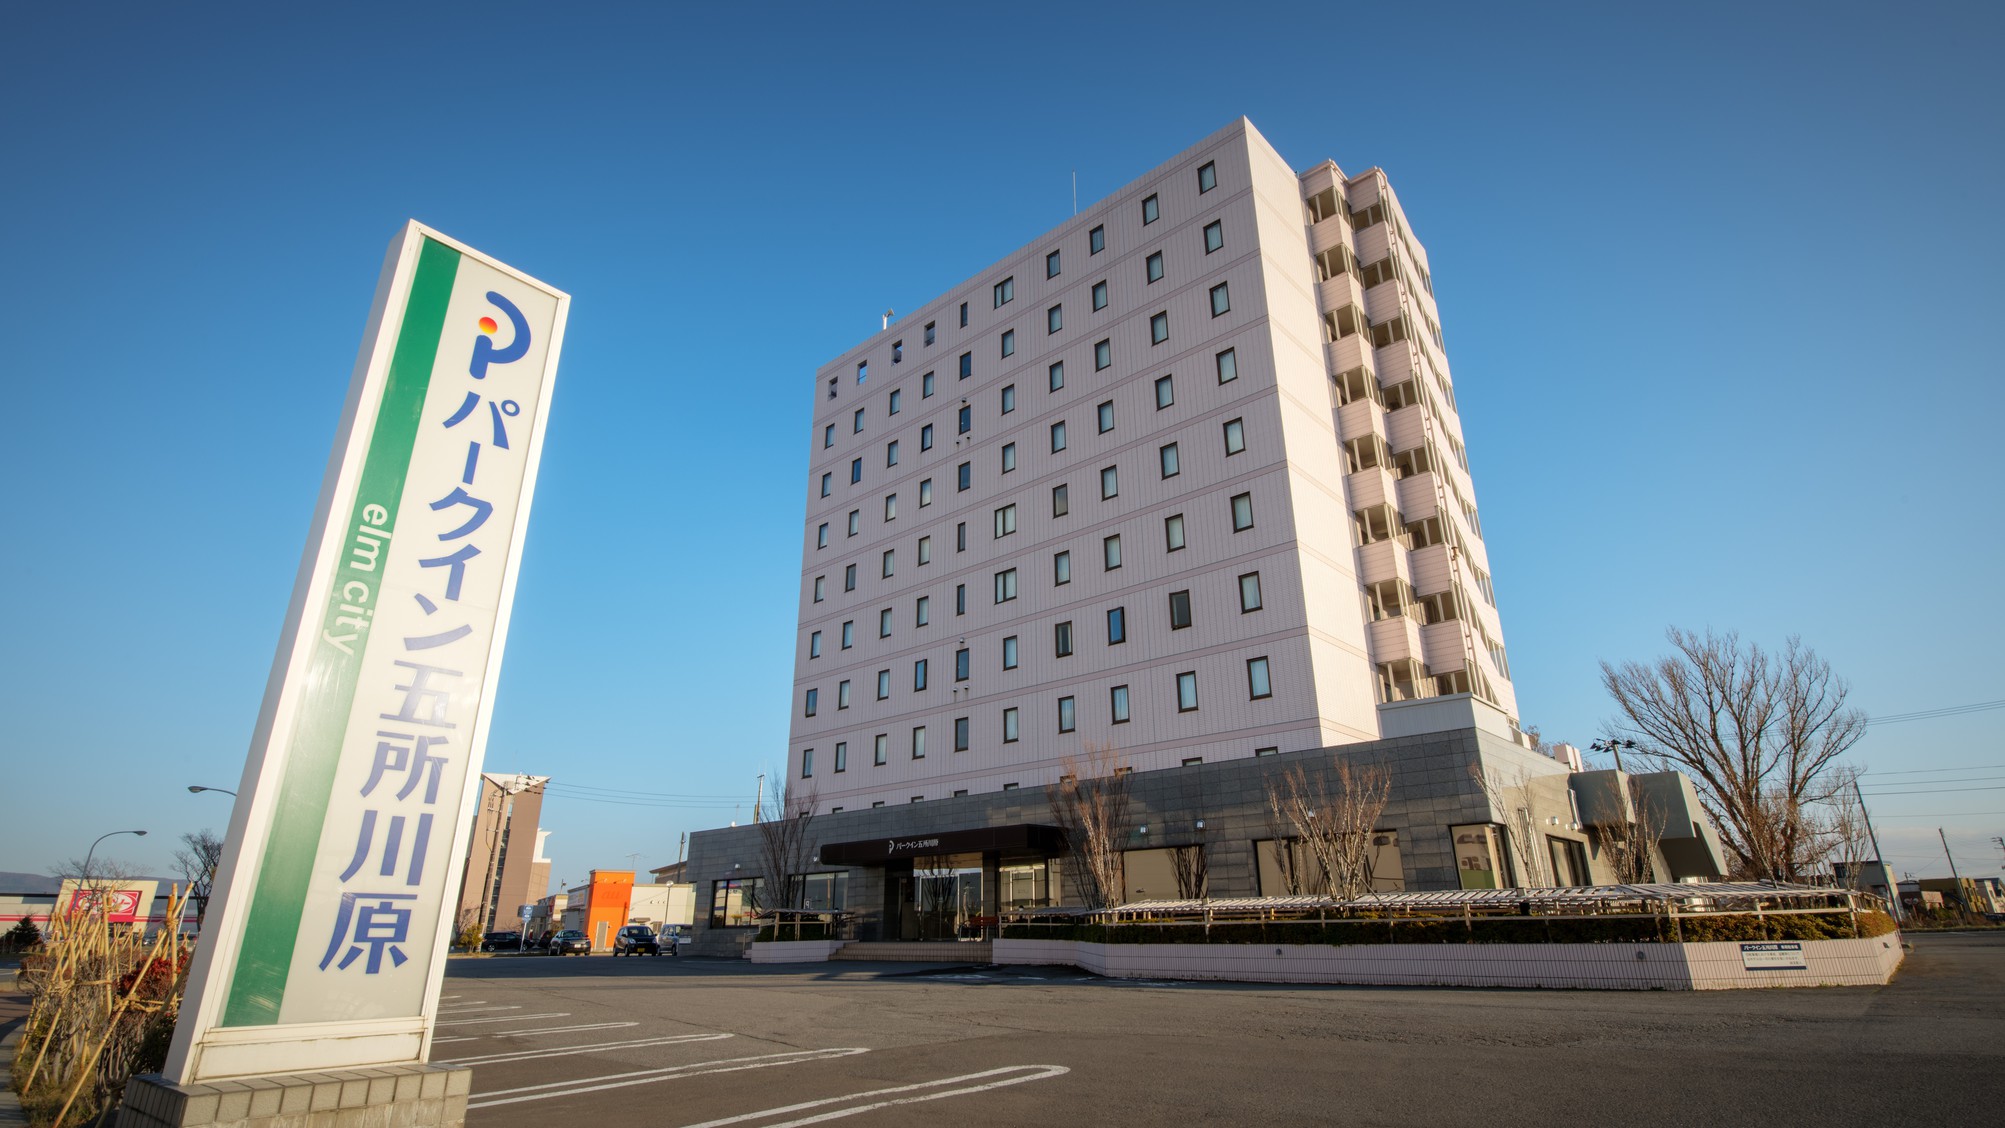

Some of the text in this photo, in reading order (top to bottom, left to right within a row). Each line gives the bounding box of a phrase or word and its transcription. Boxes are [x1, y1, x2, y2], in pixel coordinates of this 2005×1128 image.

[319, 391, 520, 974] パークイン五所川原
[323, 503, 392, 657] elm city
